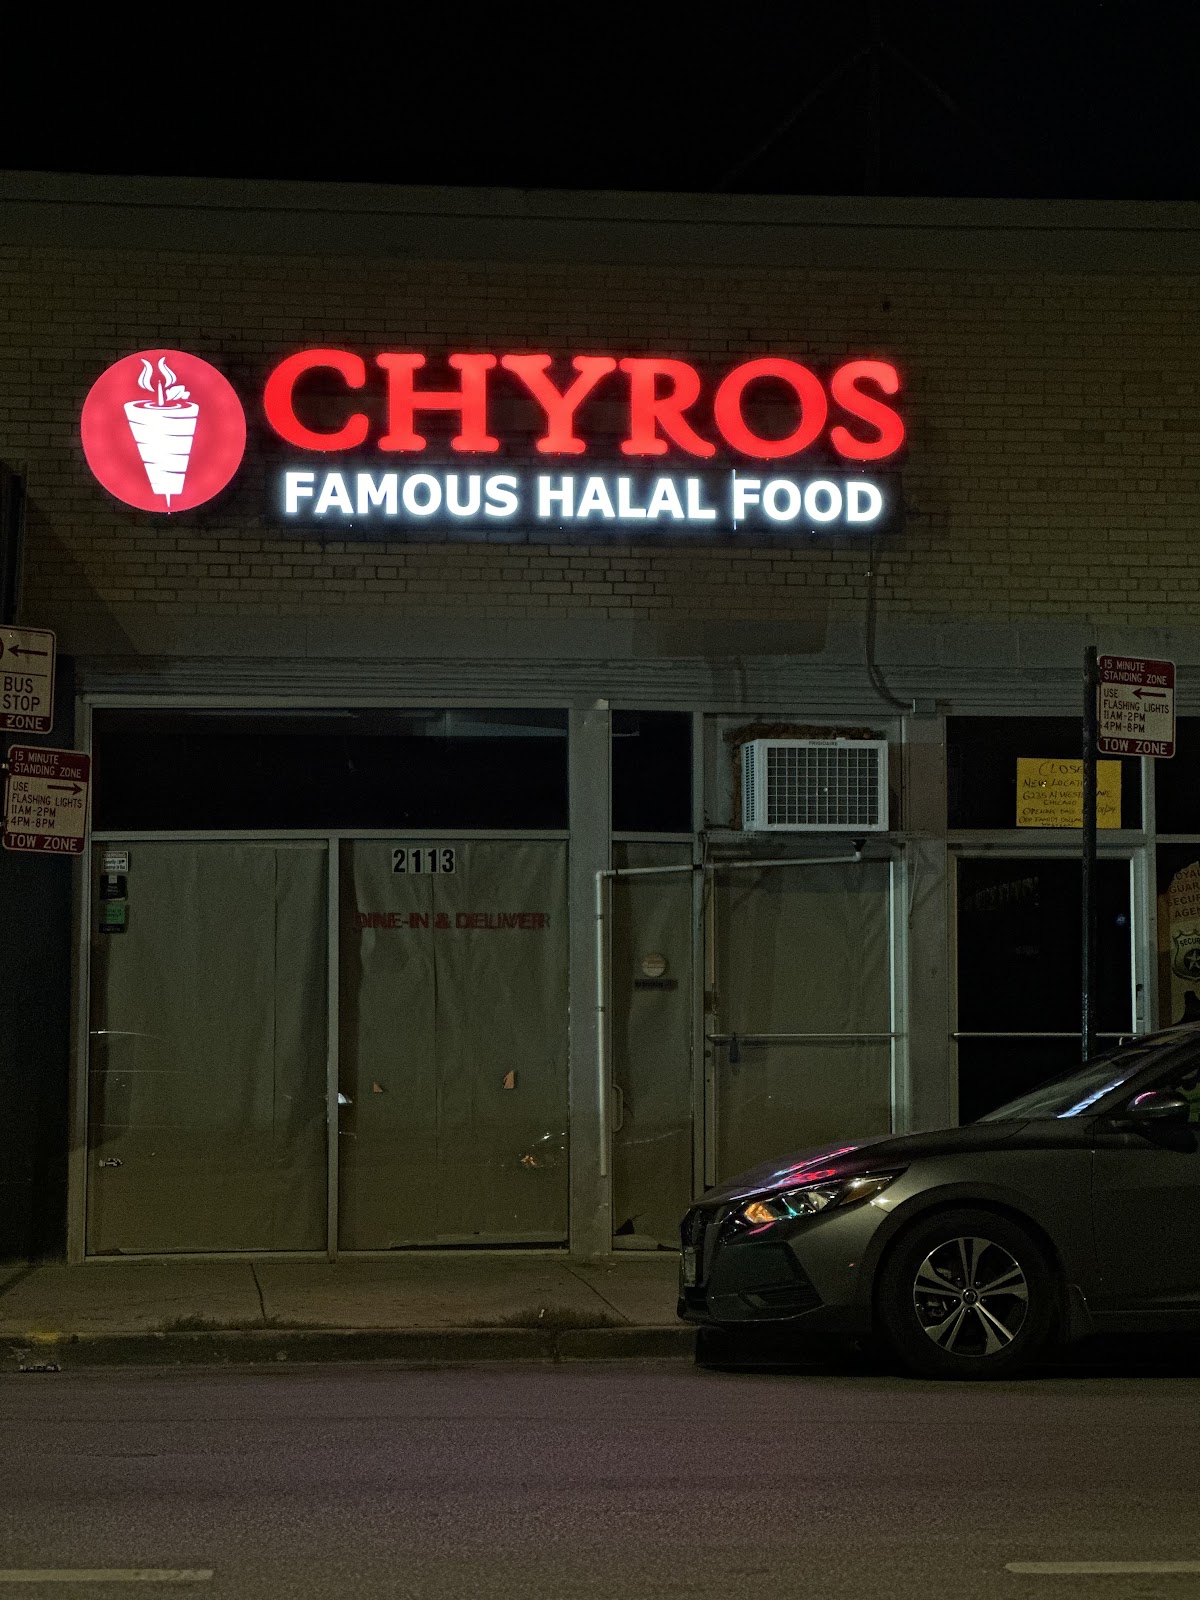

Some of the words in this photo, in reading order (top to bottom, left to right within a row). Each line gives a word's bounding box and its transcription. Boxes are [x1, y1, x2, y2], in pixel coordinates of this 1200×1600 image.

[263, 349, 905, 461] CHYROS
[284, 471, 519, 519] FAMOUS
[537, 474, 716, 521] HALAL
[732, 477, 883, 524] FOOD
[1104, 659, 1113, 669] 15
[1116, 660, 1145, 672] MINUTE
[3, 676, 33, 693] BUS
[1104, 670, 1142, 683] STANDING
[1146, 674, 1167, 685] ZONE
[1103, 688, 1118, 698] USE
[3, 694, 40, 712] STOP
[1103, 699, 1140, 711] FLASHING
[1144, 702, 1169, 714] LIGHTS
[7, 715, 44, 730] ZONE
[1103, 710, 1146, 722] 11AM-2PM
[1104, 738, 1129, 751] TOW
[1135, 741, 1168, 755] ZONE
[15, 750, 24, 761] 15
[28, 752, 59, 765] MINUTE
[14, 763, 55, 776] STANDING
[60, 766, 82, 779] ZONE
[1039, 761, 1083, 777] CLOSE
[13, 781, 29, 792] USE
[1051, 778, 1083, 787] LOCATI
[12, 792, 51, 806] FLASHING
[55, 796, 82, 809] LIGHTS
[11, 805, 56, 818] 11AM-2PM
[10, 816, 55, 829] 4PM-8PM
[10, 834, 36, 848] TOW
[43, 837, 77, 851] ZONE
[393, 849, 454, 873] 2113
[1170, 881, 1200, 894] GUAR
[1167, 893, 1200, 908] SECUR
[1180, 936, 1200, 947] SECUR
